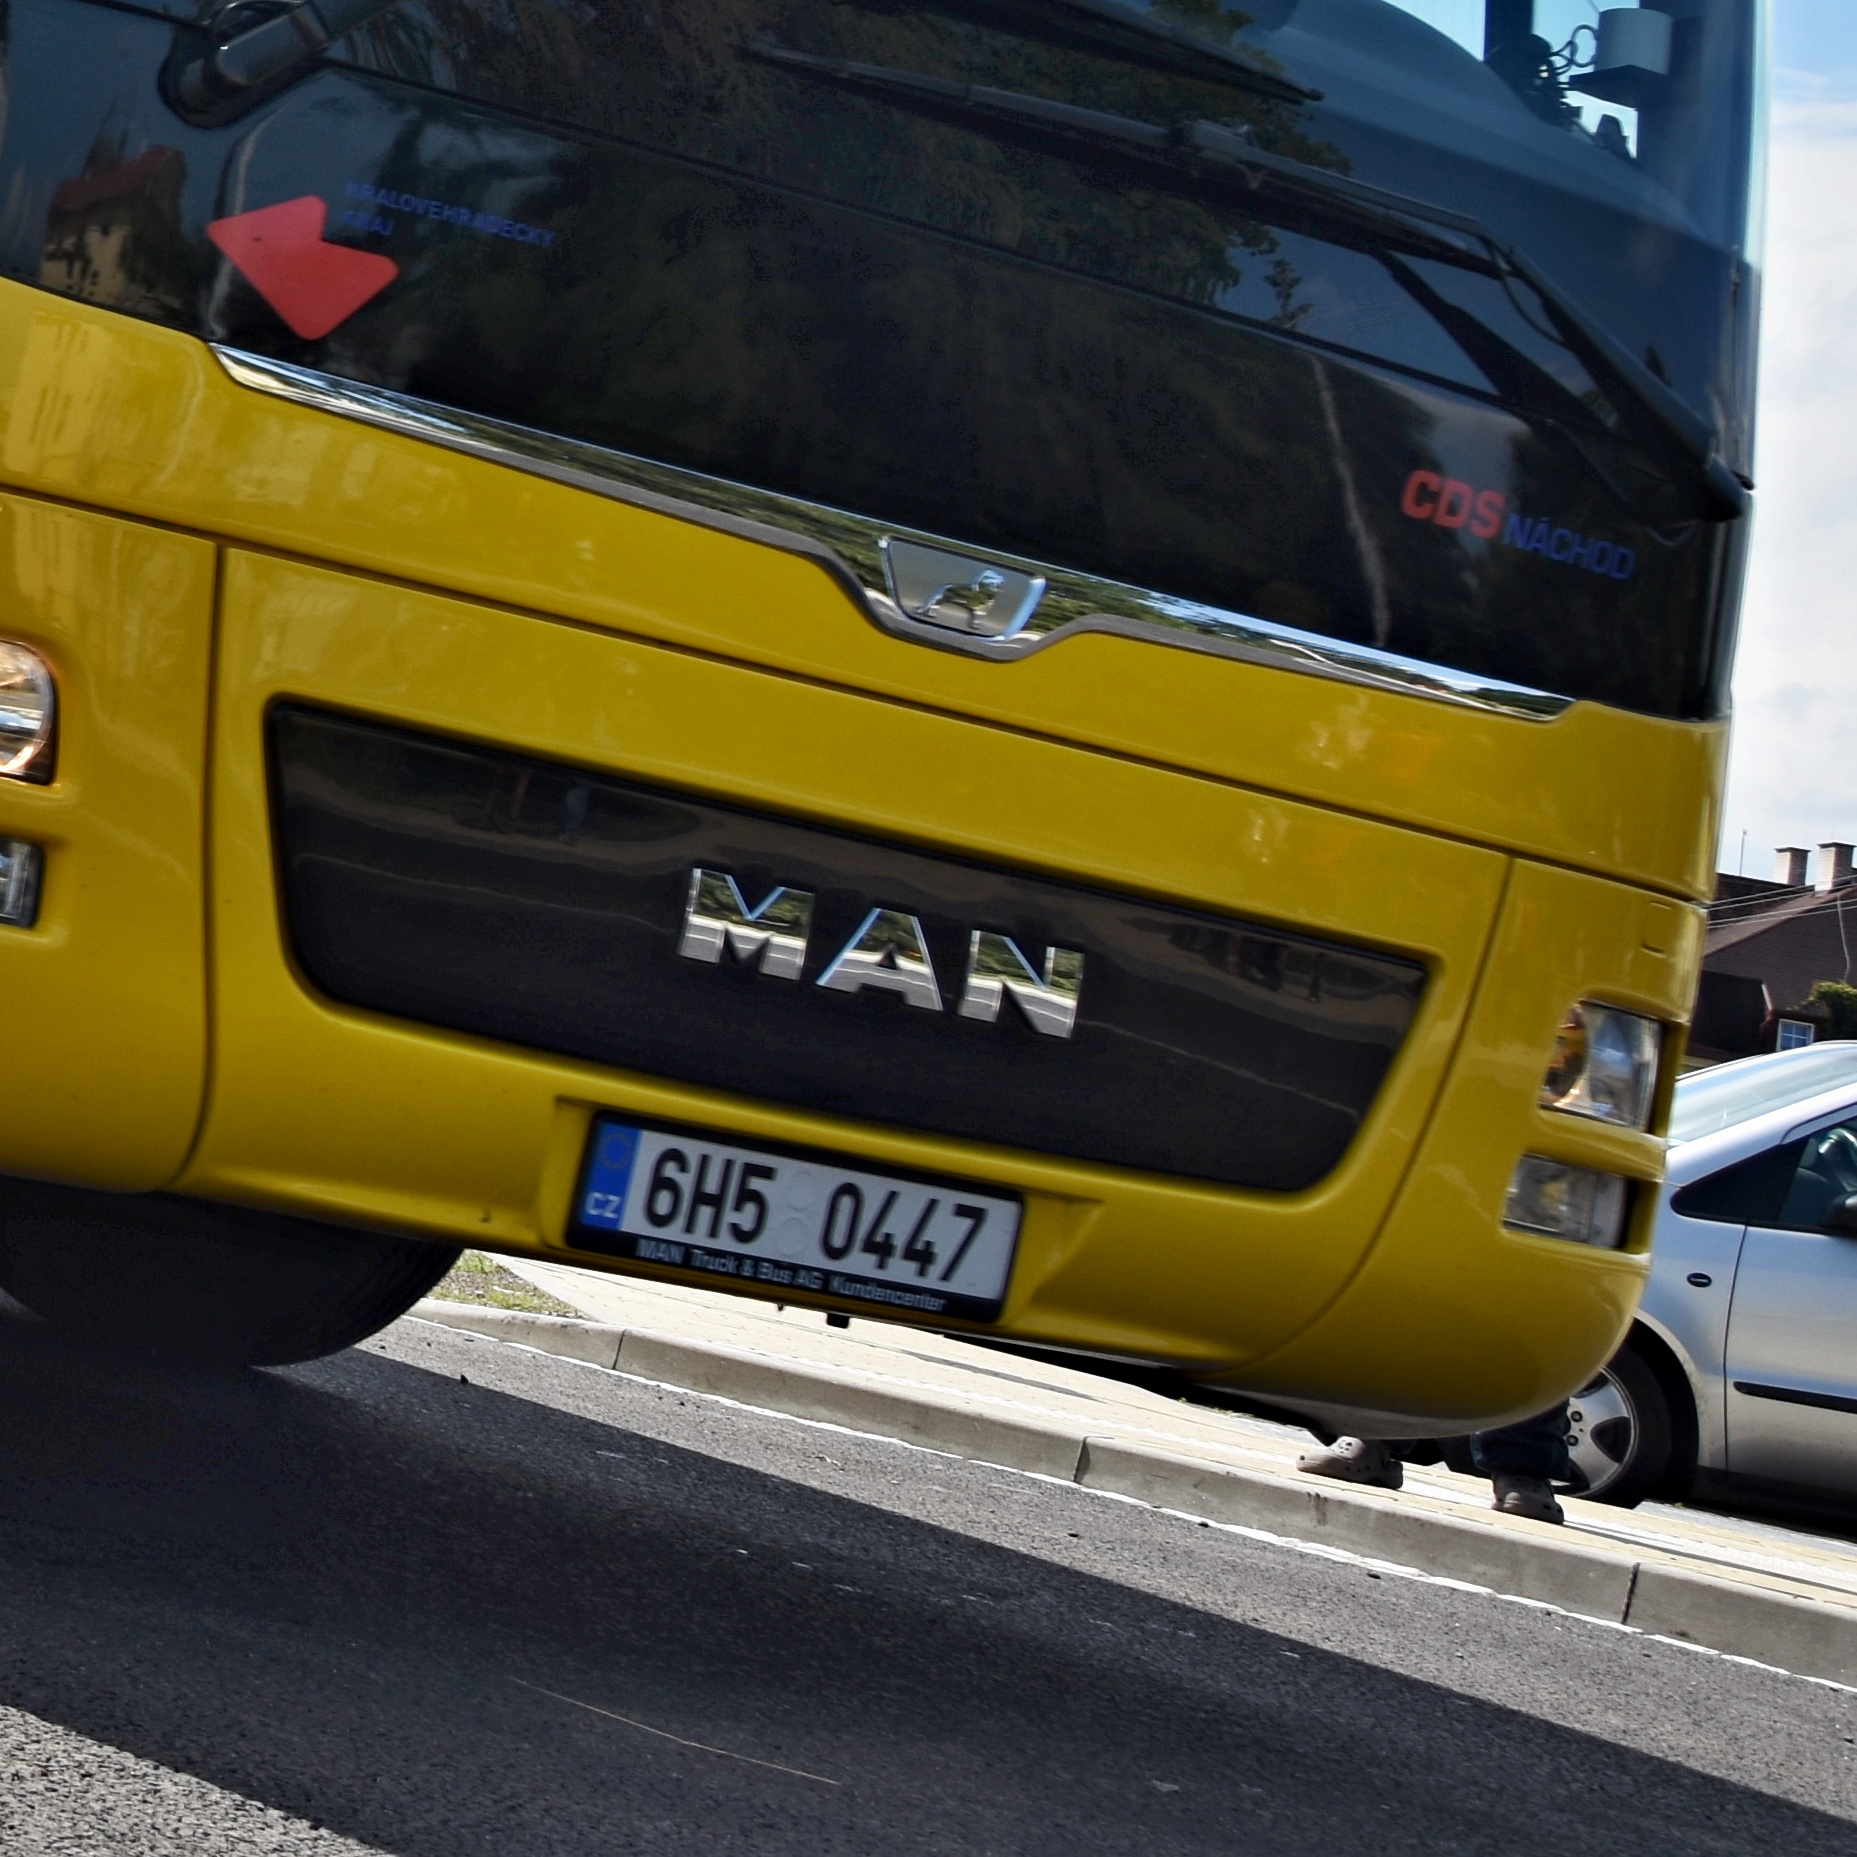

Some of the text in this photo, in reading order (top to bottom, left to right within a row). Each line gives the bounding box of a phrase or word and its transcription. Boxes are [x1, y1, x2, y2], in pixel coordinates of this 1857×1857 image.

[1400, 469, 1637, 580] CDS NÁCHOD
[679, 867, 1085, 1038] MAN
[586, 1148, 988, 1282] CZ 6H5 0447
[636, 1238, 948, 1312] MAN Truck & Bus AG Kundencenter
